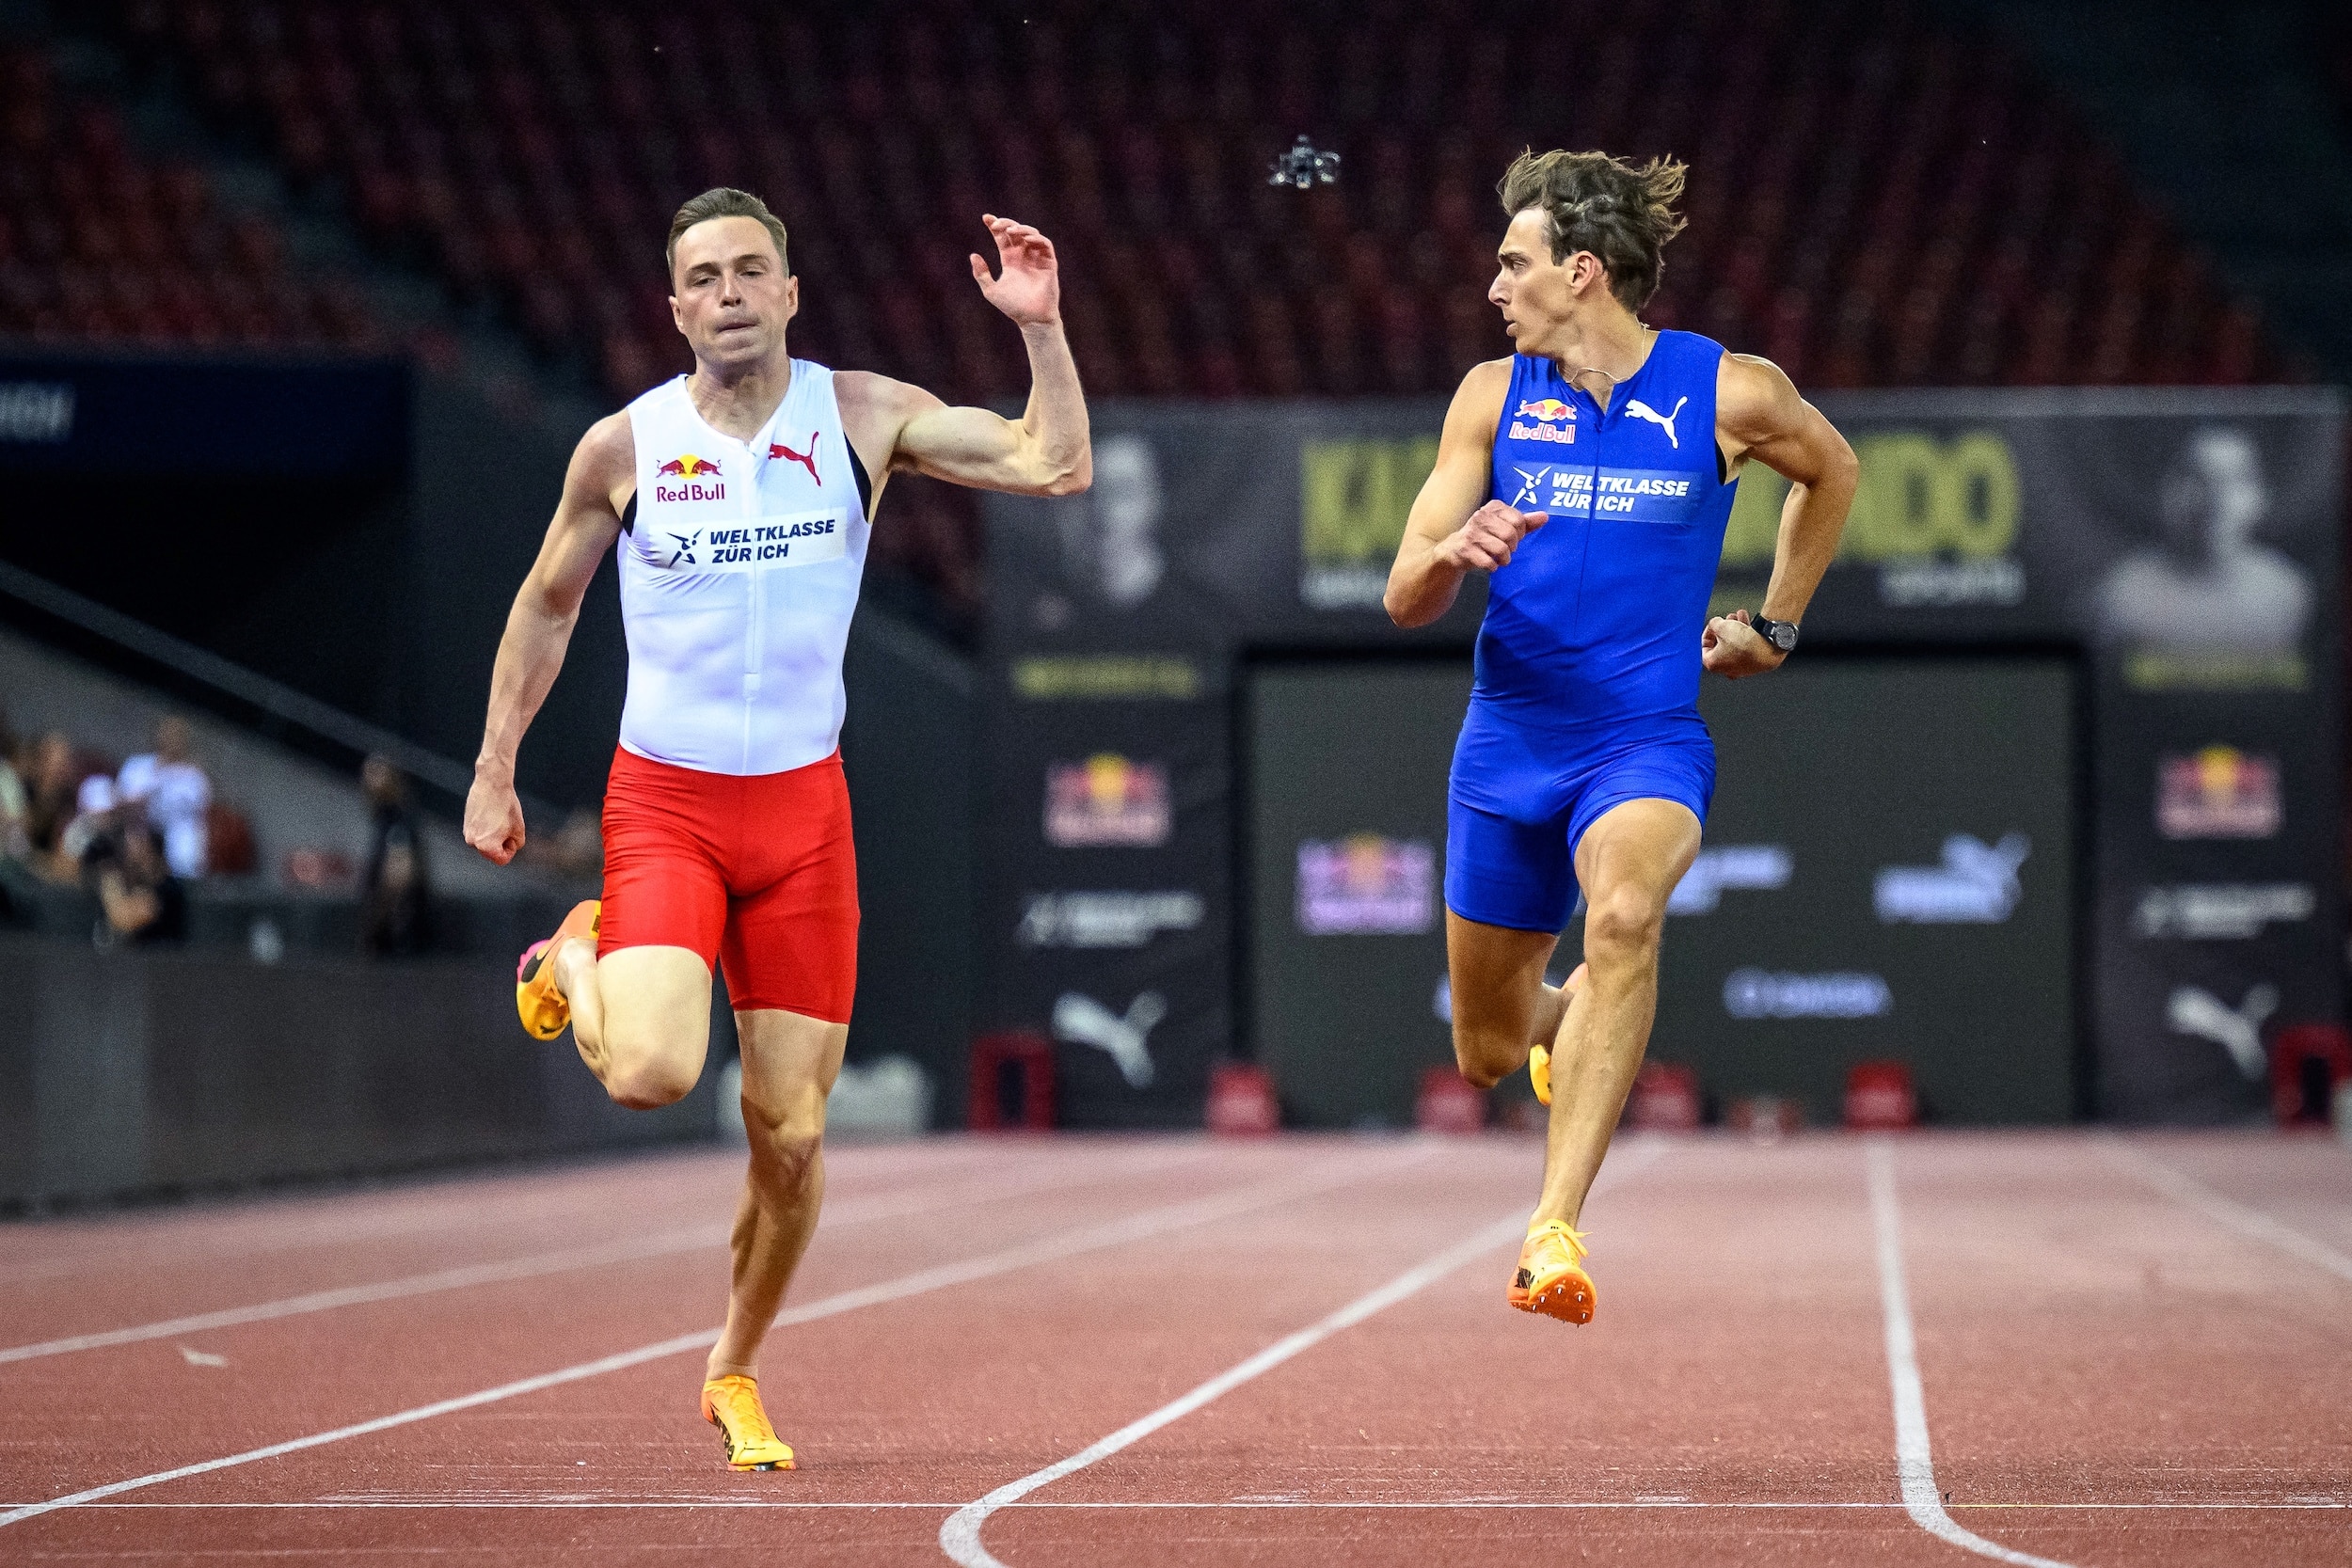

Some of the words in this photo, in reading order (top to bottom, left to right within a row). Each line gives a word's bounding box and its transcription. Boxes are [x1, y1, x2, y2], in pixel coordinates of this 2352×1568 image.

[1510, 421, 1541, 439] Red
[1542, 424, 1576, 444] Bull
[656, 483, 688, 502] Red
[691, 483, 725, 500] Bull
[1552, 472, 1690, 497] WELTKLASSE
[1549, 489, 1634, 513] ZÜRICH
[709, 519, 835, 546] WELTKLASSE
[711, 544, 789, 563] ZÜRICH
